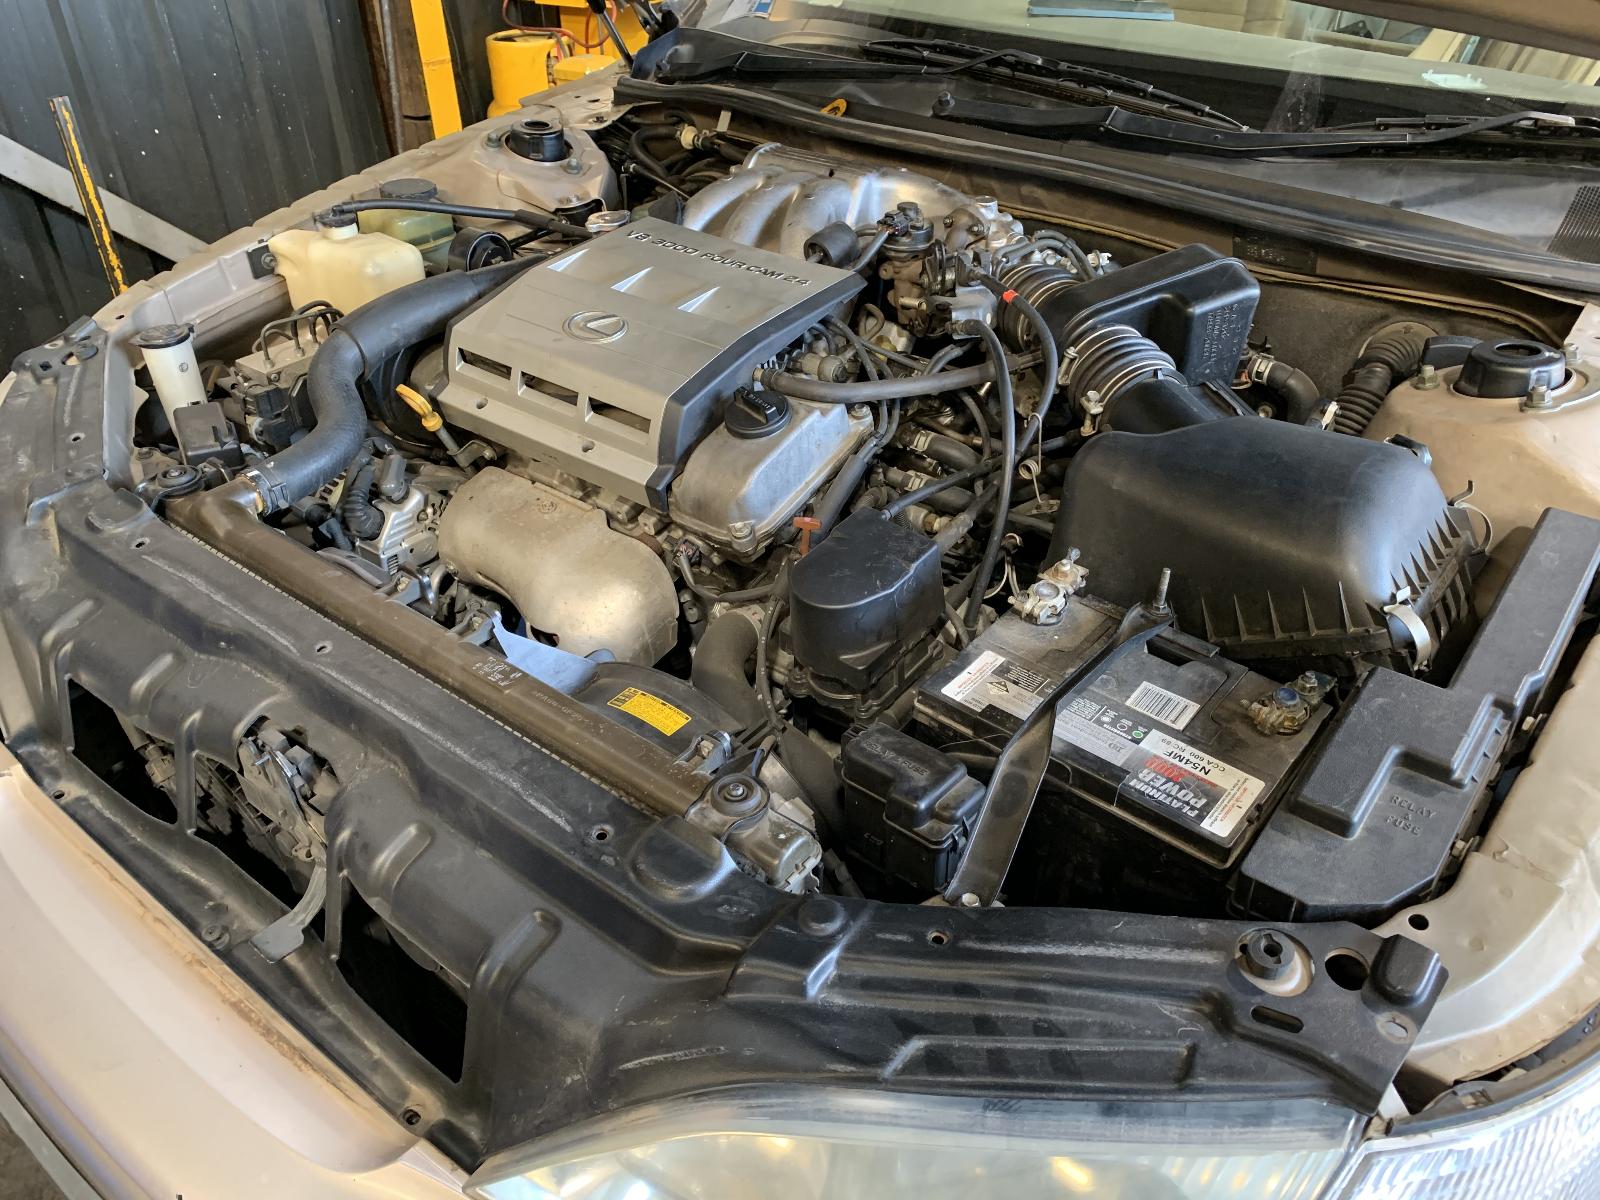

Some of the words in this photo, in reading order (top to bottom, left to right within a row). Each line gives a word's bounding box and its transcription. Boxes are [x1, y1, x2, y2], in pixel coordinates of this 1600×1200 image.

[652, 239, 700, 255] 3000
[701, 252, 747, 269] FOUR
[746, 265, 784, 280] CAM
[784, 275, 812, 287] 24
[902, 760, 929, 776] FUSE
[1164, 750, 1211, 775] N54MF
[1207, 759, 1226, 772] CCA
[1129, 779, 1199, 817] PLATINUM
[1138, 768, 1207, 808] POWER
[1391, 795, 1437, 818] RELAY
[1385, 815, 1420, 835] FUSE
